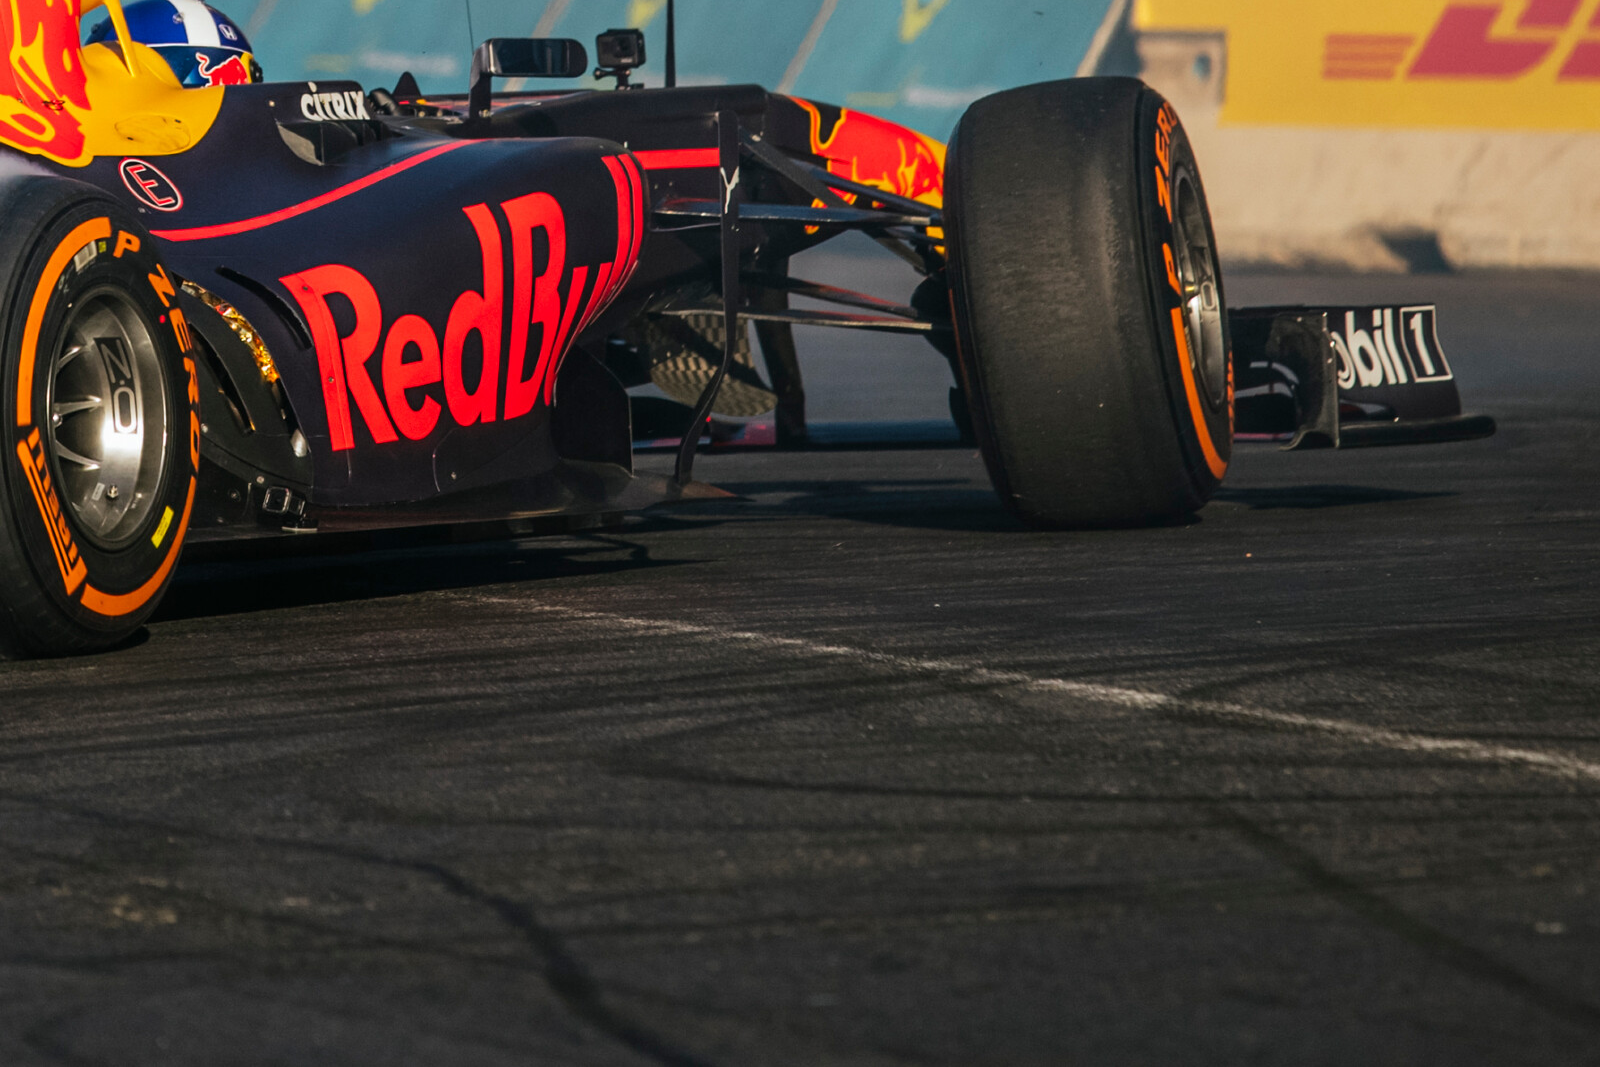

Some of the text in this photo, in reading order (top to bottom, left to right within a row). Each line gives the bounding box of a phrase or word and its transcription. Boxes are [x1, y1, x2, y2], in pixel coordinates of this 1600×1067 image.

[113, 230, 141, 259] P
[148, 263, 200, 473] ZERO
[1331, 308, 1436, 390] obil 1
